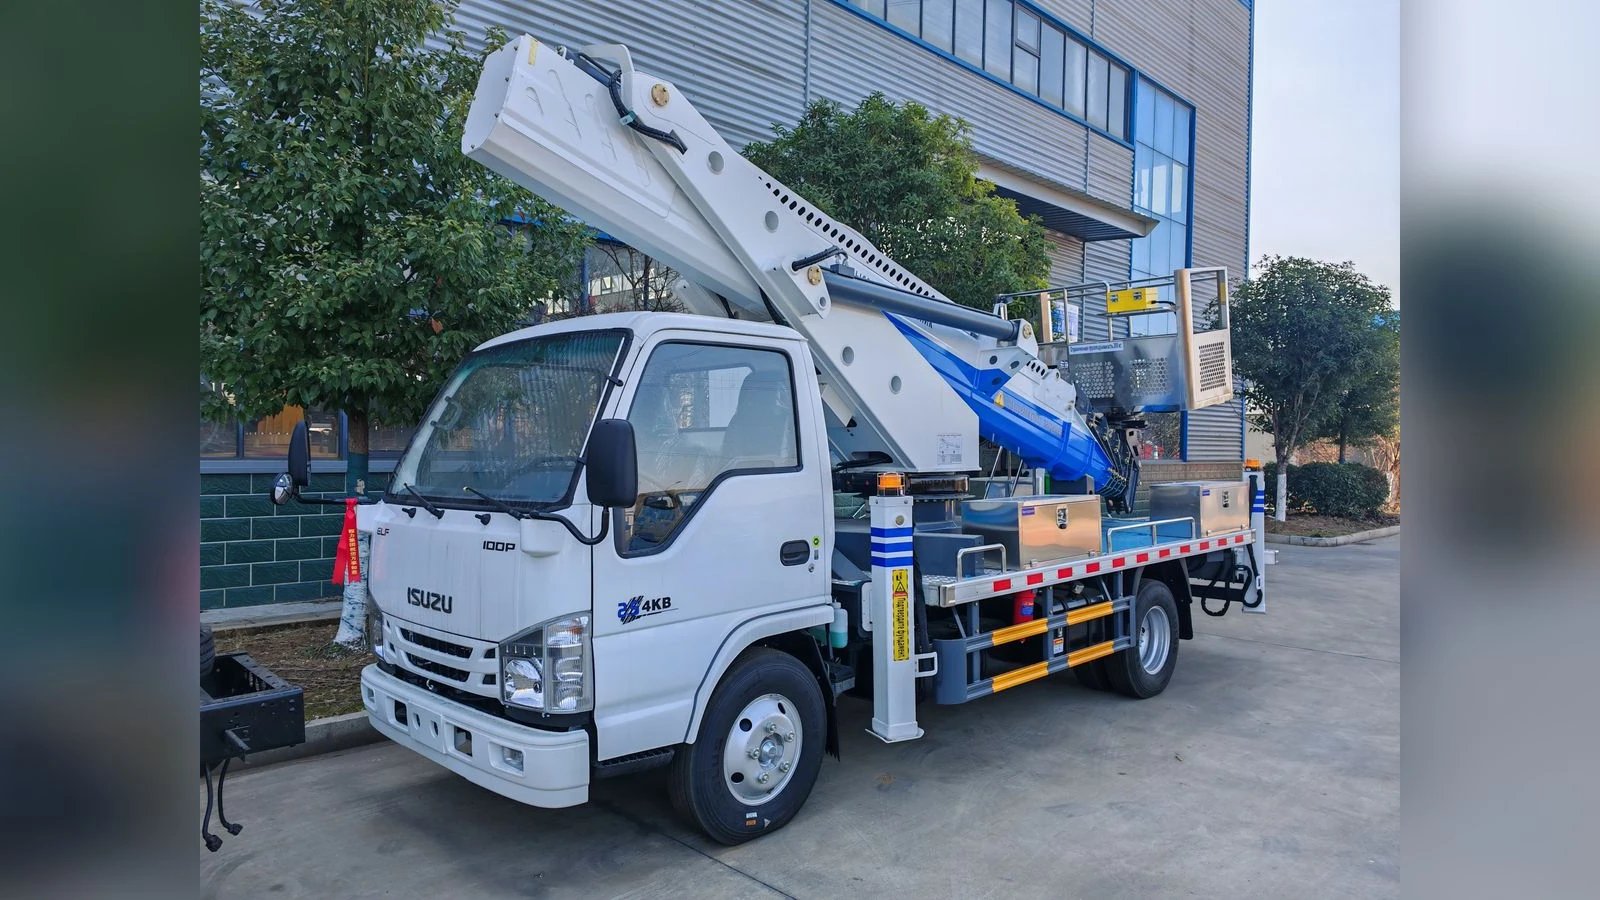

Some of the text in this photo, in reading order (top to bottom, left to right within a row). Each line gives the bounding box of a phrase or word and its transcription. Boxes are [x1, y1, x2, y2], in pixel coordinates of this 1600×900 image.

[376, 527, 390, 536] ELF
[482, 540, 516, 552] 100P
[407, 587, 453, 614] ISUZU
[641, 597, 672, 612] 4KB
